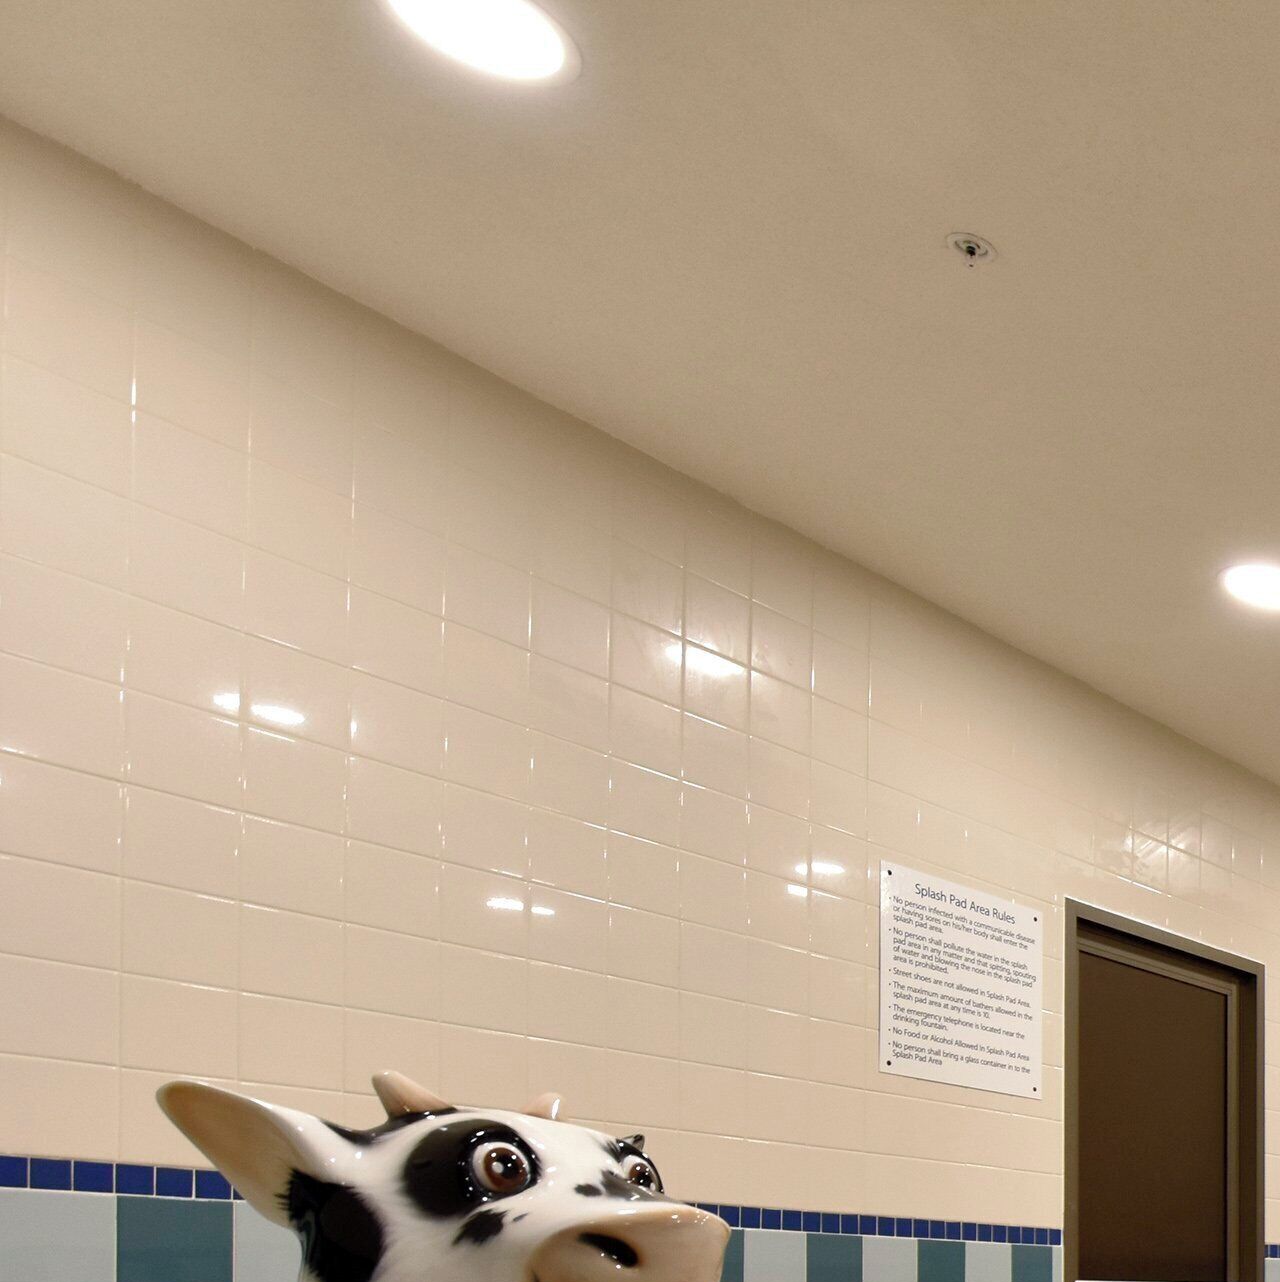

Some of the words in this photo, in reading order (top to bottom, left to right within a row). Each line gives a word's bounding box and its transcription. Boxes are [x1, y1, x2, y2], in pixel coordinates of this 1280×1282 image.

[893, 895, 904, 905] No
[903, 900, 927, 912] person
[928, 906, 954, 920] infected
[954, 914, 968, 924] with
[893, 905, 901, 913] or
[900, 906, 925, 922] having
[925, 915, 942, 925] sores
[915, 883, 947, 903] Splash
[949, 894, 967, 909] Pad
[969, 901, 990, 917] Area
[992, 907, 1016, 925] Rules
[893, 914, 914, 925] splash
[914, 920, 928, 929] pad
[928, 924, 944, 934] area.
[893, 927, 904, 936] No
[903, 931, 927, 945] person
[928, 937, 942, 947] shall
[943, 942, 965, 953] pollute
[965, 947, 976, 956] the
[893, 937, 907, 947] pad
[907, 941, 922, 950] area
[930, 947, 942, 958] any
[893, 945, 901, 953] of
[901, 948, 920, 958] water
[920, 953, 934, 962] and
[934, 955, 960, 970] blowing
[960, 963, 971, 972] the
[893, 955, 907, 964] area
[914, 960, 949, 975] prohibited.
[892, 967, 913, 979] Street
[913, 973, 932, 984] shoes
[943, 981, 955, 989] not
[955, 984, 979, 995] allowed
[892, 981, 906, 991] The
[906, 985, 939, 999] maximum
[939, 994, 964, 1005] amount
[972, 1000, 994, 1012] bathers
[892, 991, 914, 1001] splash
[914, 996, 927, 1005] pad
[928, 1000, 942, 1008] area
[950, 1005, 961, 1014] any
[892, 1004, 906, 1014] The
[905, 1008, 943, 1023] emergency
[943, 1016, 974, 1029] telephone
[980, 1023, 1002, 1035] located
[892, 1013, 920, 1027] drinking
[920, 1019, 948, 1031] fountain.
[892, 1026, 903, 1035] No
[903, 1029, 921, 1039] Food
[929, 1034, 954, 1046] Alcohol
[953, 1039, 979, 1051] Allowed
[892, 1040, 903, 1049] No
[903, 1044, 927, 1056] person
[926, 1048, 941, 1057] shall
[942, 1050, 959, 1062] bring
[892, 1049, 914, 1060] Splash
[914, 1053, 927, 1063] Pad
[927, 1056, 943, 1066] Area
